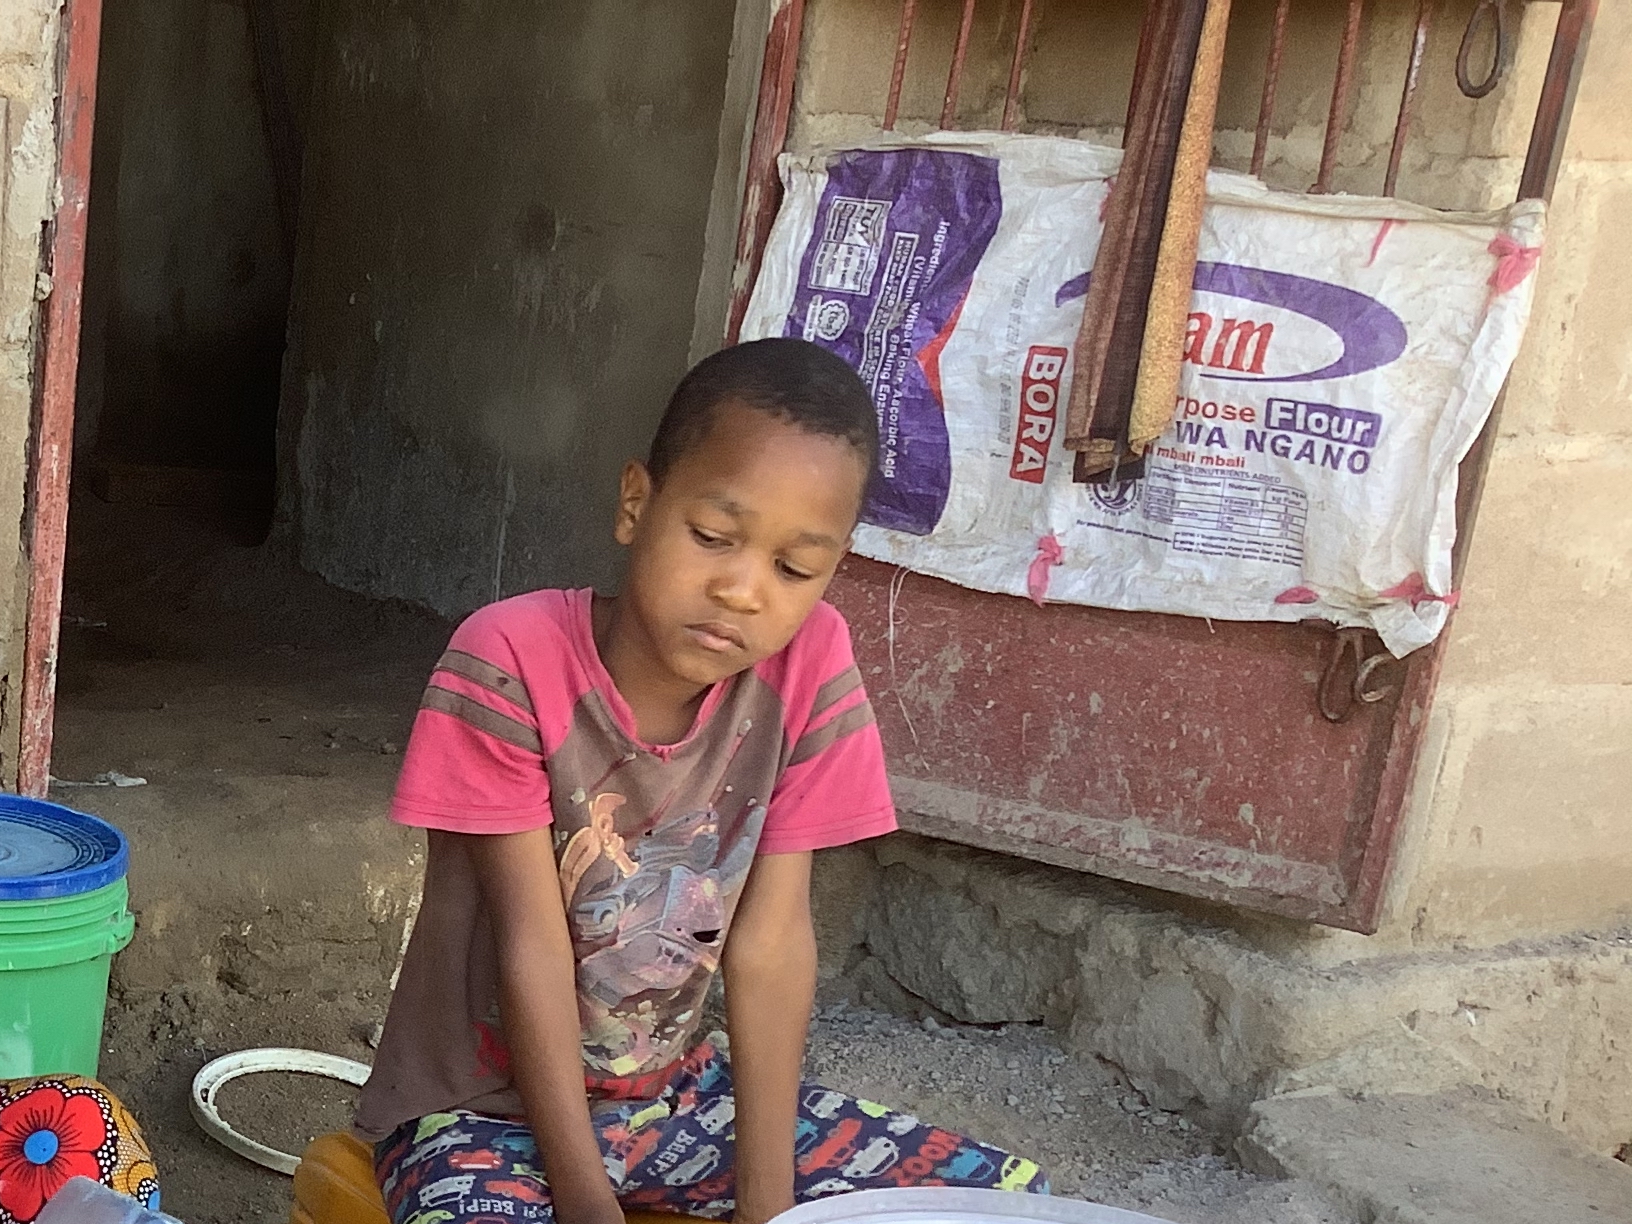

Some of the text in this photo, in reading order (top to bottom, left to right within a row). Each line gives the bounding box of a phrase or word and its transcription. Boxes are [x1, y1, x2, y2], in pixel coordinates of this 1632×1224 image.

[1182, 312, 1273, 375] am
[1014, 354, 1063, 472] BORA
[1174, 395, 1372, 443] rpose Flour
[882, 449, 898, 478] Acid
[1156, 446, 1195, 462] mbali
[1200, 454, 1246, 469] mbali
[1175, 421, 1371, 475] WA NGANO
[458, 1198, 516, 1216] BEEP!
